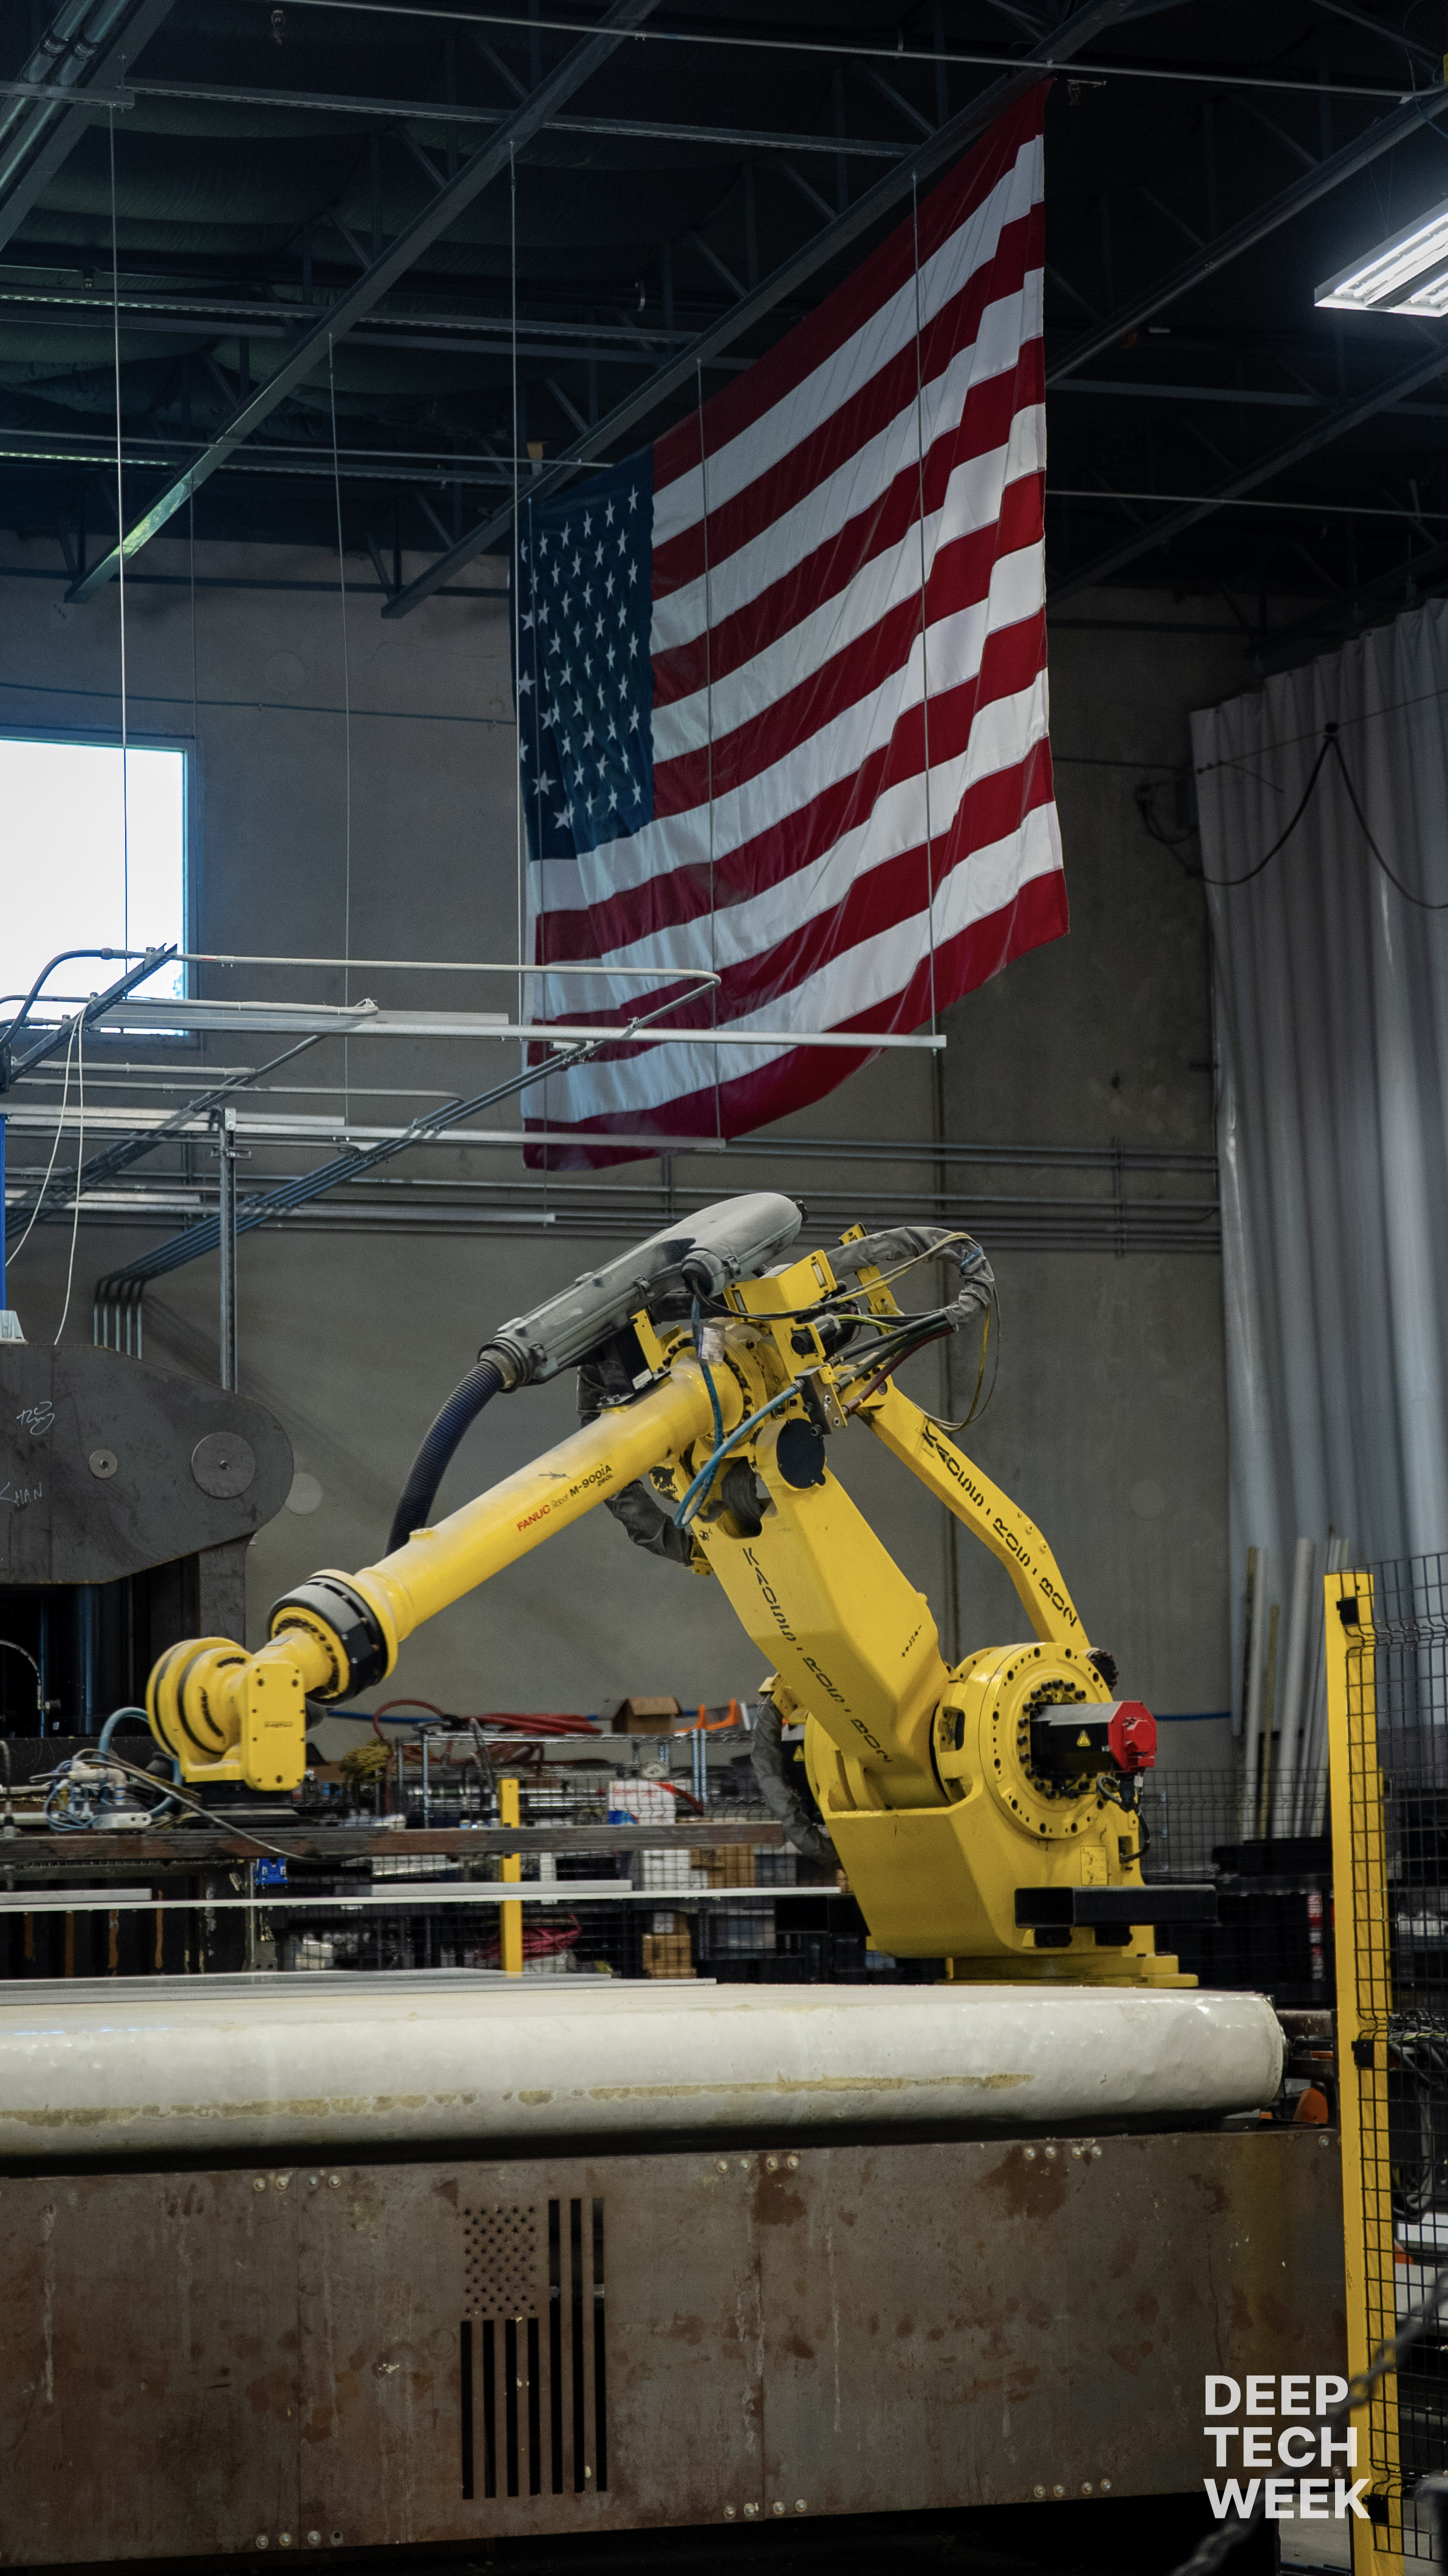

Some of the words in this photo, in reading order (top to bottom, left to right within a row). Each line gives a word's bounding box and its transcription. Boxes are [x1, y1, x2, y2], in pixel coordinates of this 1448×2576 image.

[517, 1504, 551, 1532] FANUC
[552, 1493, 569, 1509] Robot
[569, 1464, 612, 1496] M-900iA
